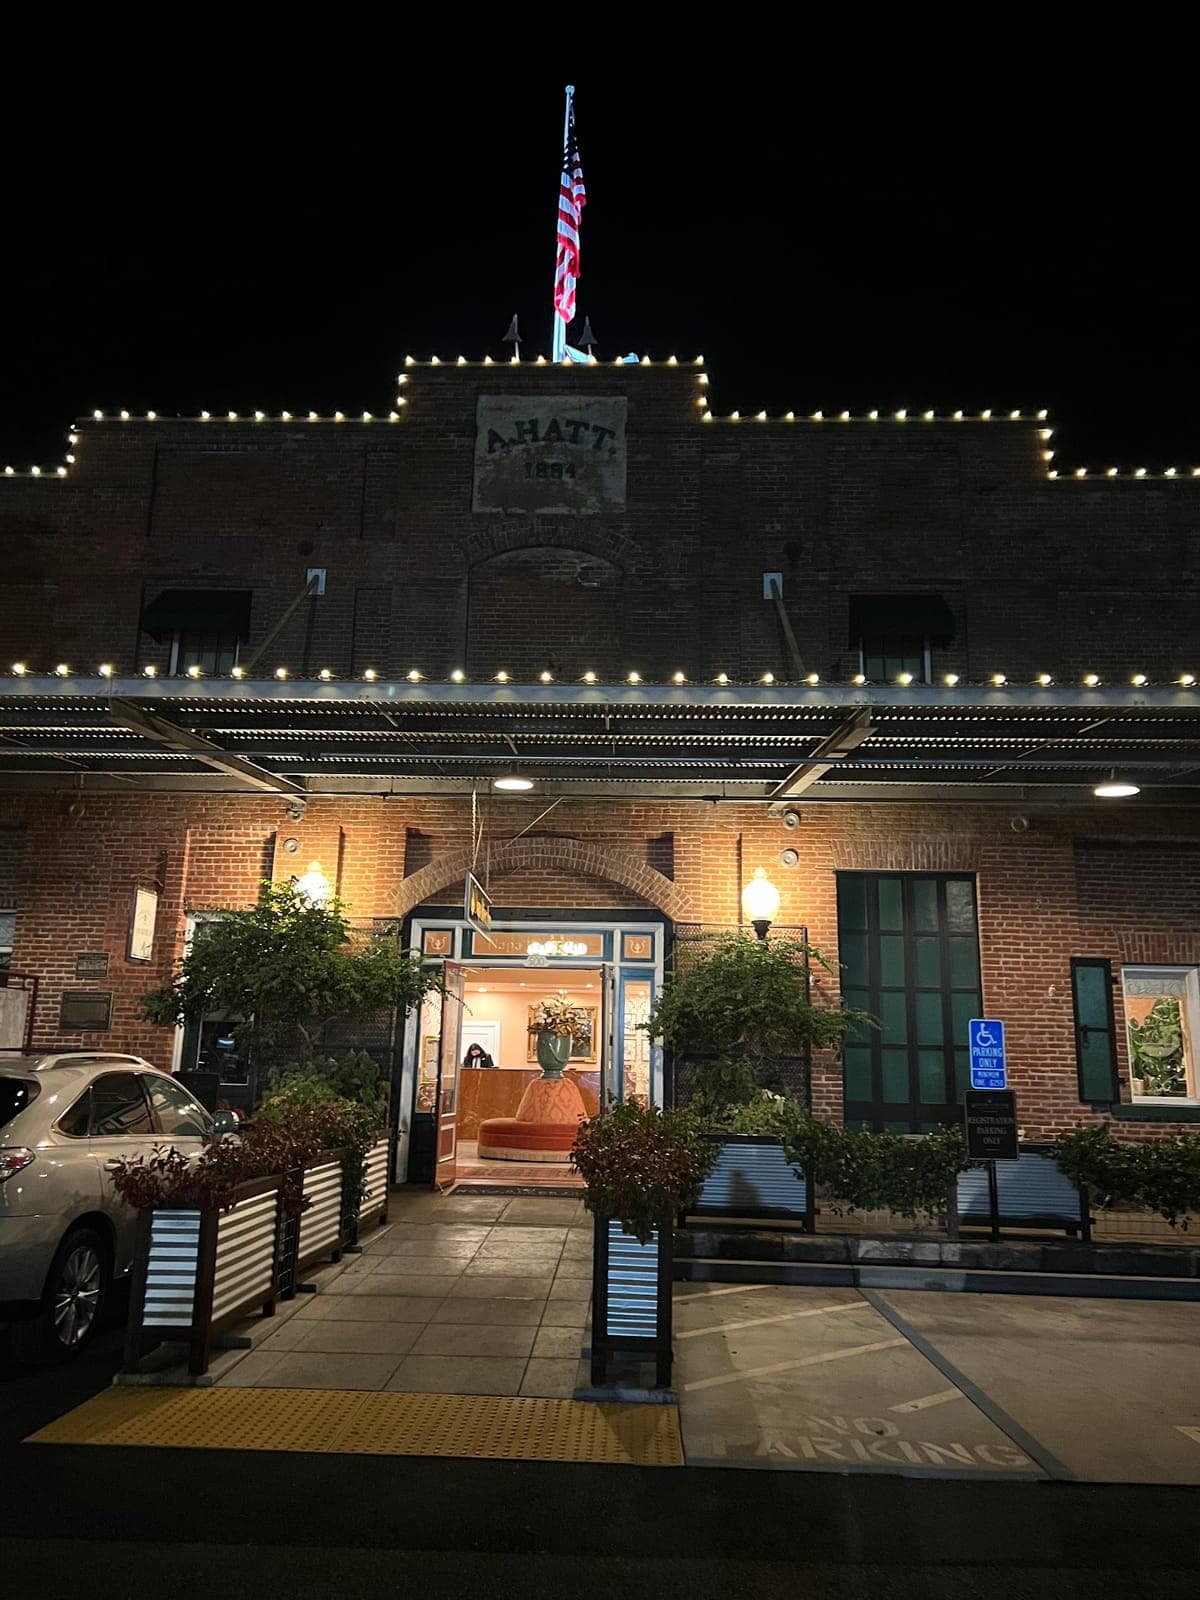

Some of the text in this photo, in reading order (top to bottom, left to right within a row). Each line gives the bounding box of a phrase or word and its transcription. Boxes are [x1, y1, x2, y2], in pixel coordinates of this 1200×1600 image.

[488, 938, 522, 952] Napa
[973, 1047, 1003, 1057] PARKING
[978, 1058, 997, 1068] ONLY
[976, 1127, 1008, 1135] PARKING
[983, 1137, 1001, 1145] ONLY
[804, 1414, 901, 1438] NO
